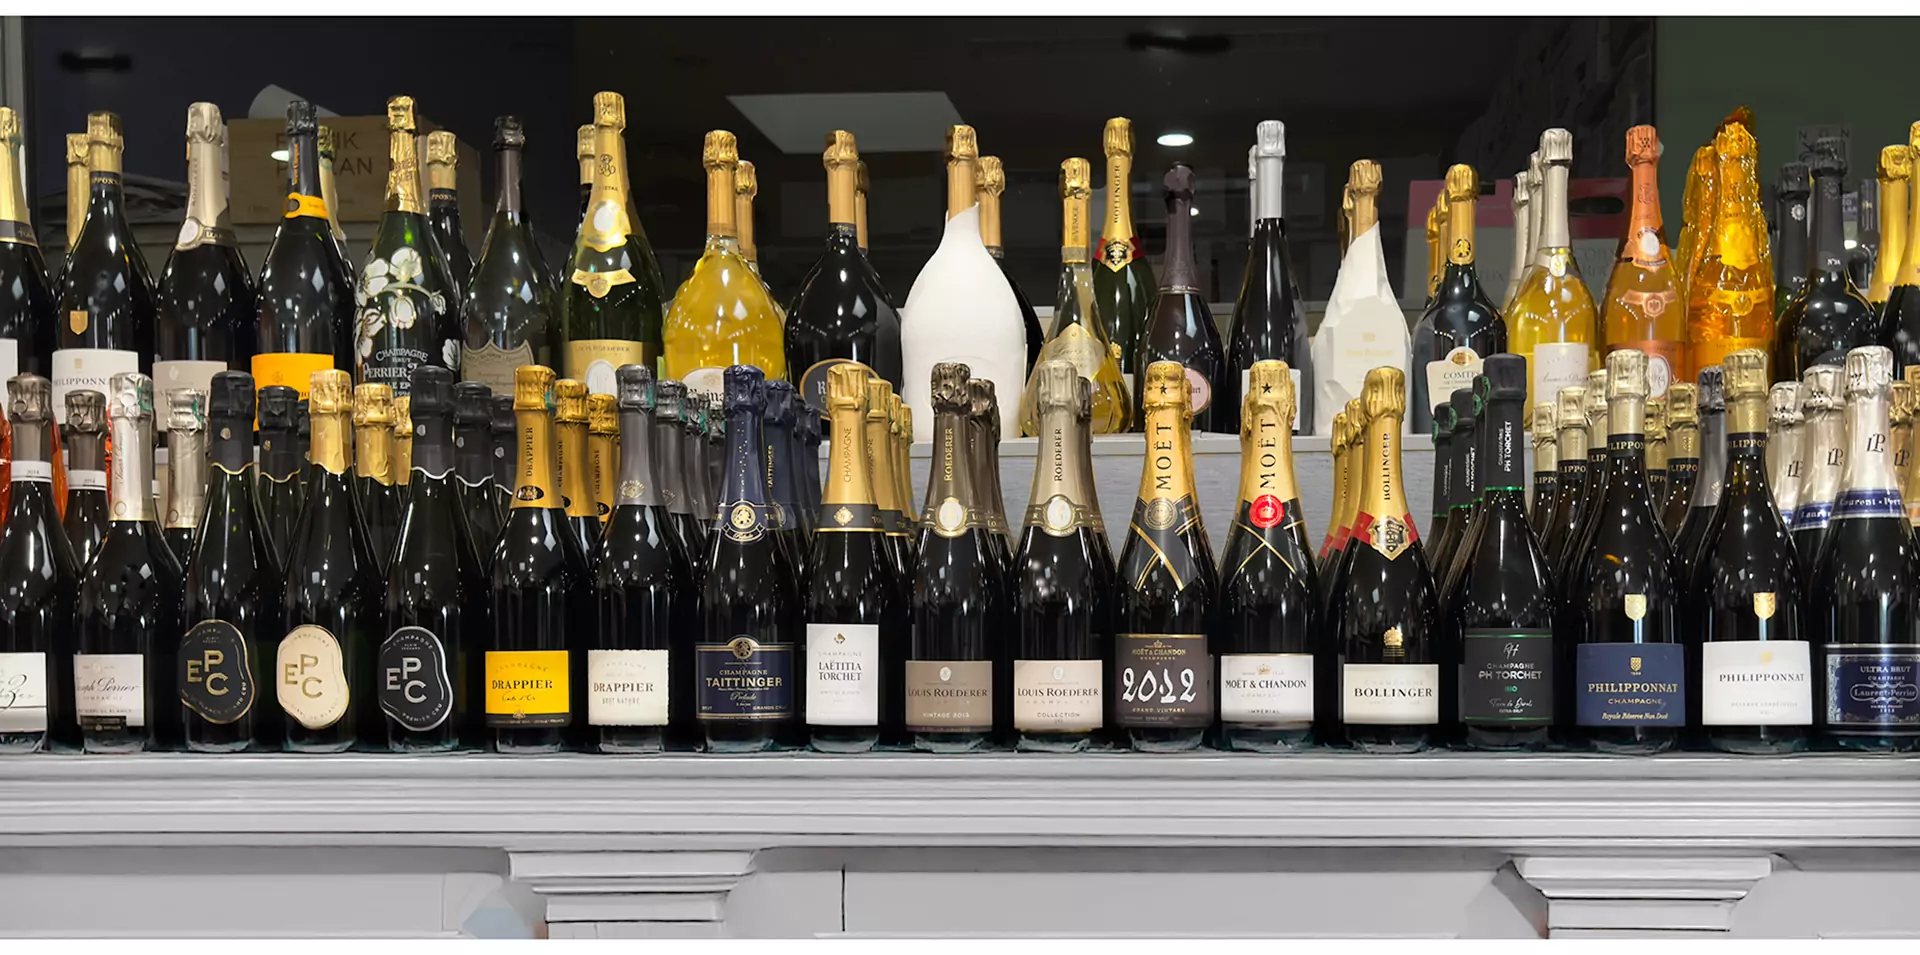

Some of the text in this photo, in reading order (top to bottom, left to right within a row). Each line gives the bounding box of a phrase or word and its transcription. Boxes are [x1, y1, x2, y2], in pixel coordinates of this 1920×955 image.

[376, 348, 428, 362] CHAMPAGNE
[362, 364, 407, 382] PERRIER
[844, 427, 852, 484] CHAMPAGNE
[944, 428, 953, 482] ROEDERER
[1154, 422, 1172, 490] MOËT
[1258, 418, 1276, 490] MOËT
[1382, 433, 1391, 500] BOLLINGER
[1504, 460, 1512, 472] PH
[392, 634, 434, 650] CHAMPAGNE
[818, 660, 862, 670] LAËTITIA
[818, 672, 862, 681] TORCHET
[1478, 671, 1542, 680] PH TORCHET
[1719, 673, 1804, 682] PHILIPPONNAT
[98, 677, 140, 692] Perrier
[492, 680, 553, 690] DRAPPIER
[594, 682, 654, 692] DRAPPIER
[706, 677, 782, 687] TAITTINGER
[1122, 667, 1197, 704] 2012
[1225, 678, 1307, 688] MOËT & CHANDON
[1588, 682, 1678, 693] PHILIPPONNAT
[908, 688, 988, 697] LOUIS ROEDERER
[1017, 687, 1099, 697] LOUIS ROEDERER
[1354, 688, 1432, 697] BOLLINGER
[402, 703, 443, 722] PREMIER CRU
